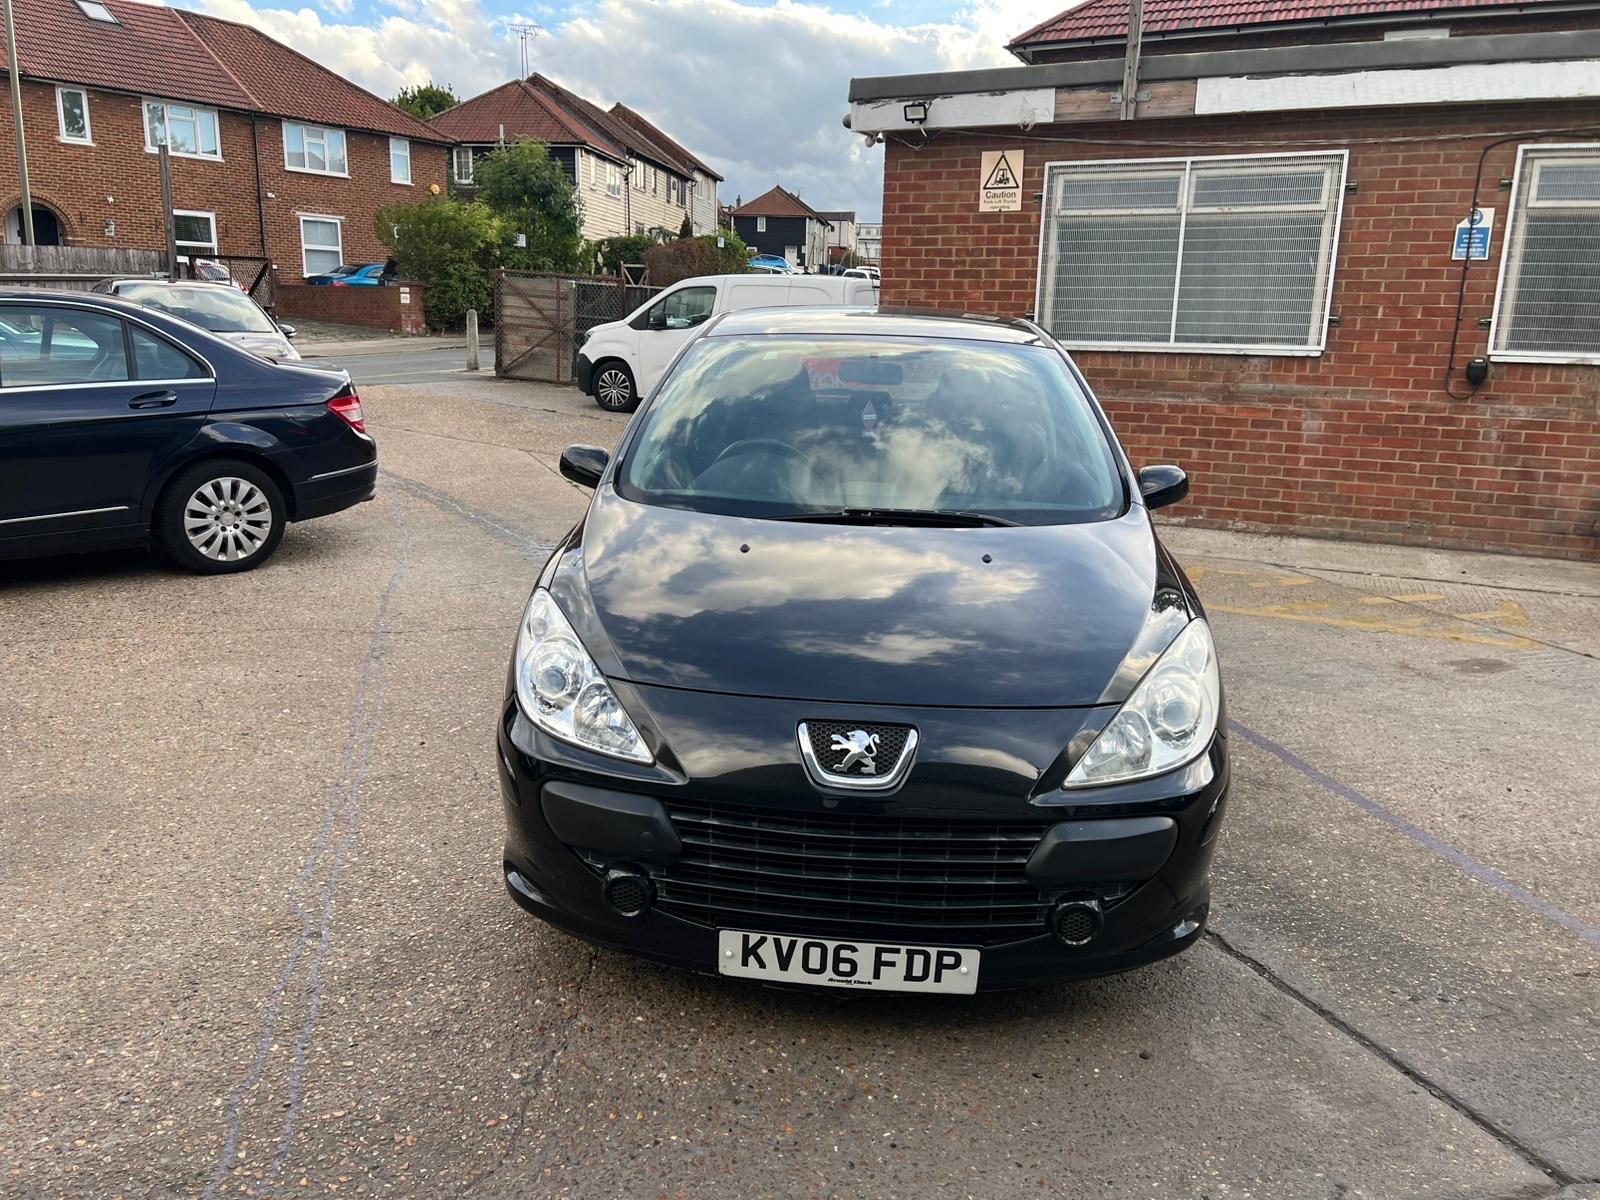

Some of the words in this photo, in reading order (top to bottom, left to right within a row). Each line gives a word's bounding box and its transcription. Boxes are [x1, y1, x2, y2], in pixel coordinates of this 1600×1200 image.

[985, 191, 1016, 199] Caution
[741, 934, 858, 977] KV06
[873, 947, 962, 983] FDP
